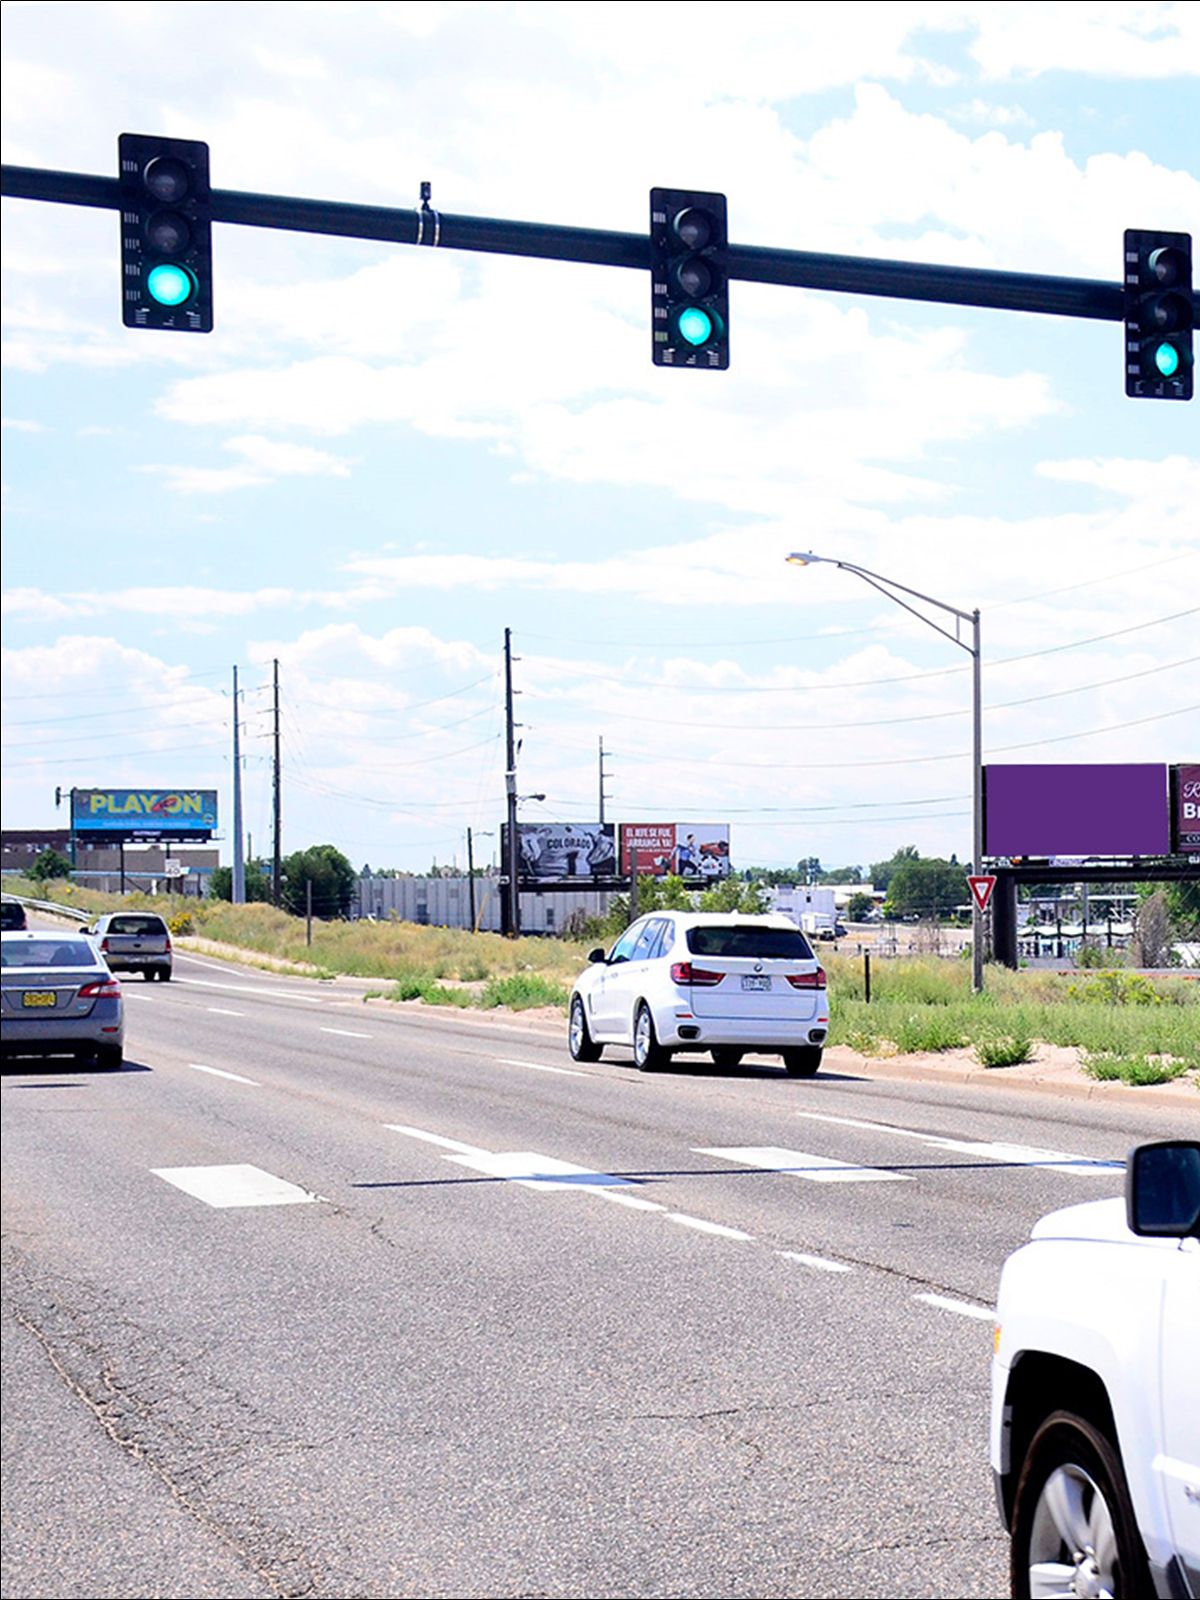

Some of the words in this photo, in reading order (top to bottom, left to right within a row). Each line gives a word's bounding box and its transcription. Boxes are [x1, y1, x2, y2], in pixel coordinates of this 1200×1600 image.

[90, 794, 159, 813] PLAY
[164, 794, 202, 813] ON
[546, 838, 591, 850] COLORADO
